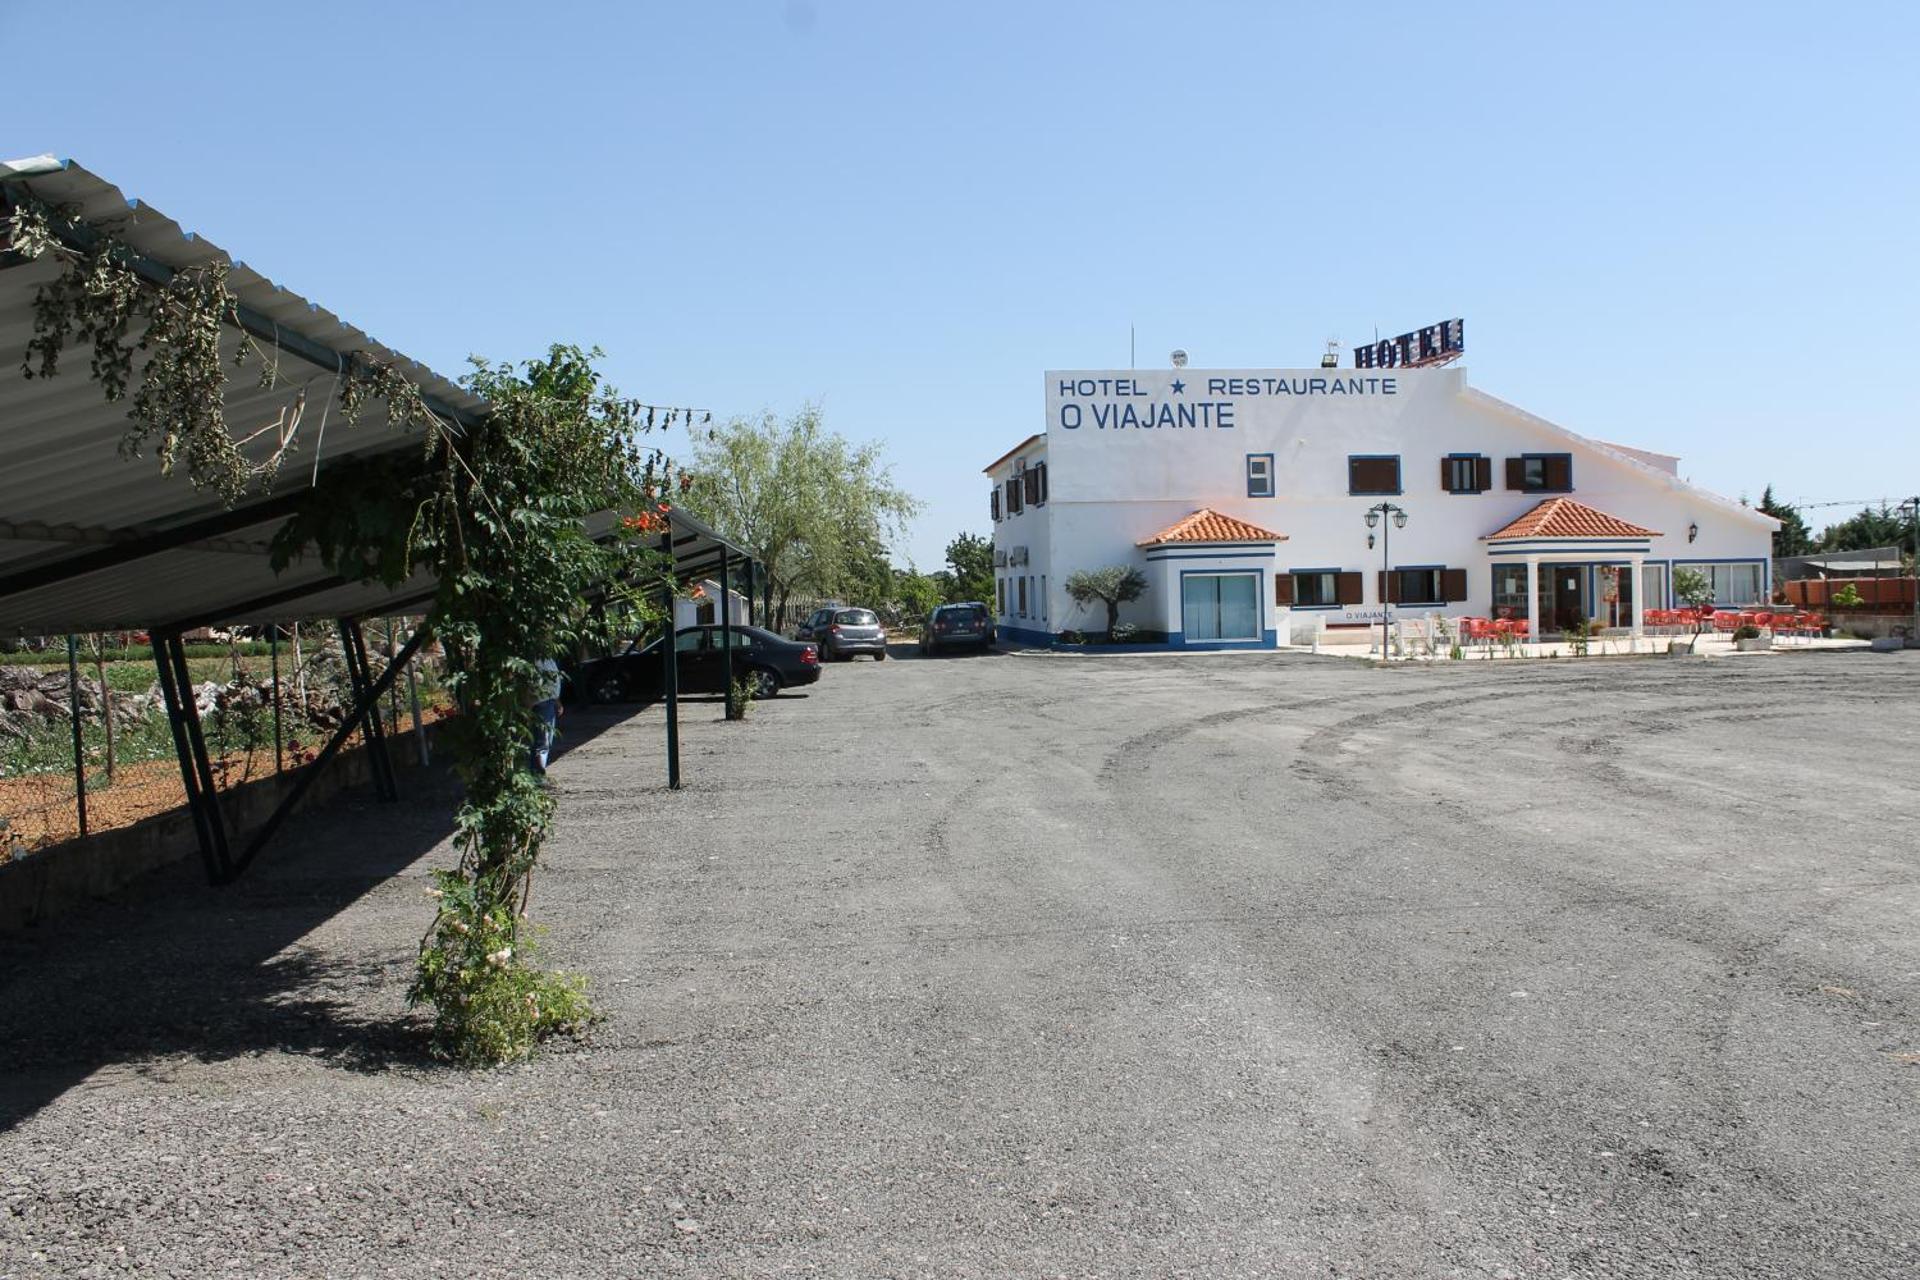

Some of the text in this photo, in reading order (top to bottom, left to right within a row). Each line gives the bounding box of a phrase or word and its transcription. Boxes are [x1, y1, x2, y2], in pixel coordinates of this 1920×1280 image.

[1060, 378, 1396, 397] HOTEL RESTAURANTE
[1061, 402, 1235, 429] O VIAJANTE
